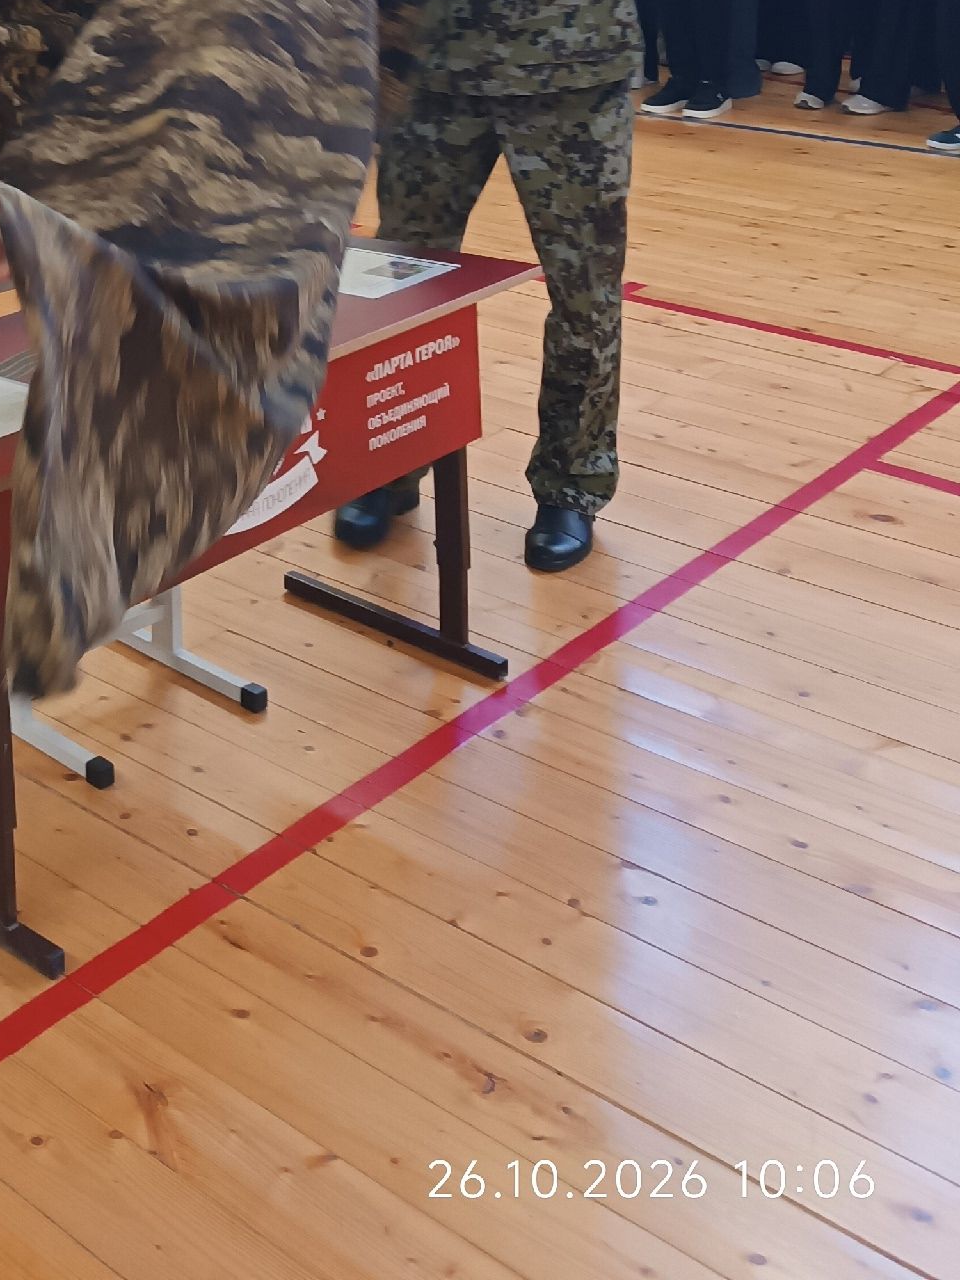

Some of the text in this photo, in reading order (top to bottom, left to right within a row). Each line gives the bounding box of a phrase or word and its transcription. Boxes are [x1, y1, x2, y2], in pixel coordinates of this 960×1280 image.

[366, 334, 461, 382] «ПАРТА ГЕРОЯ»
[368, 414, 427, 452] ПОКОЛЕНИЯ
